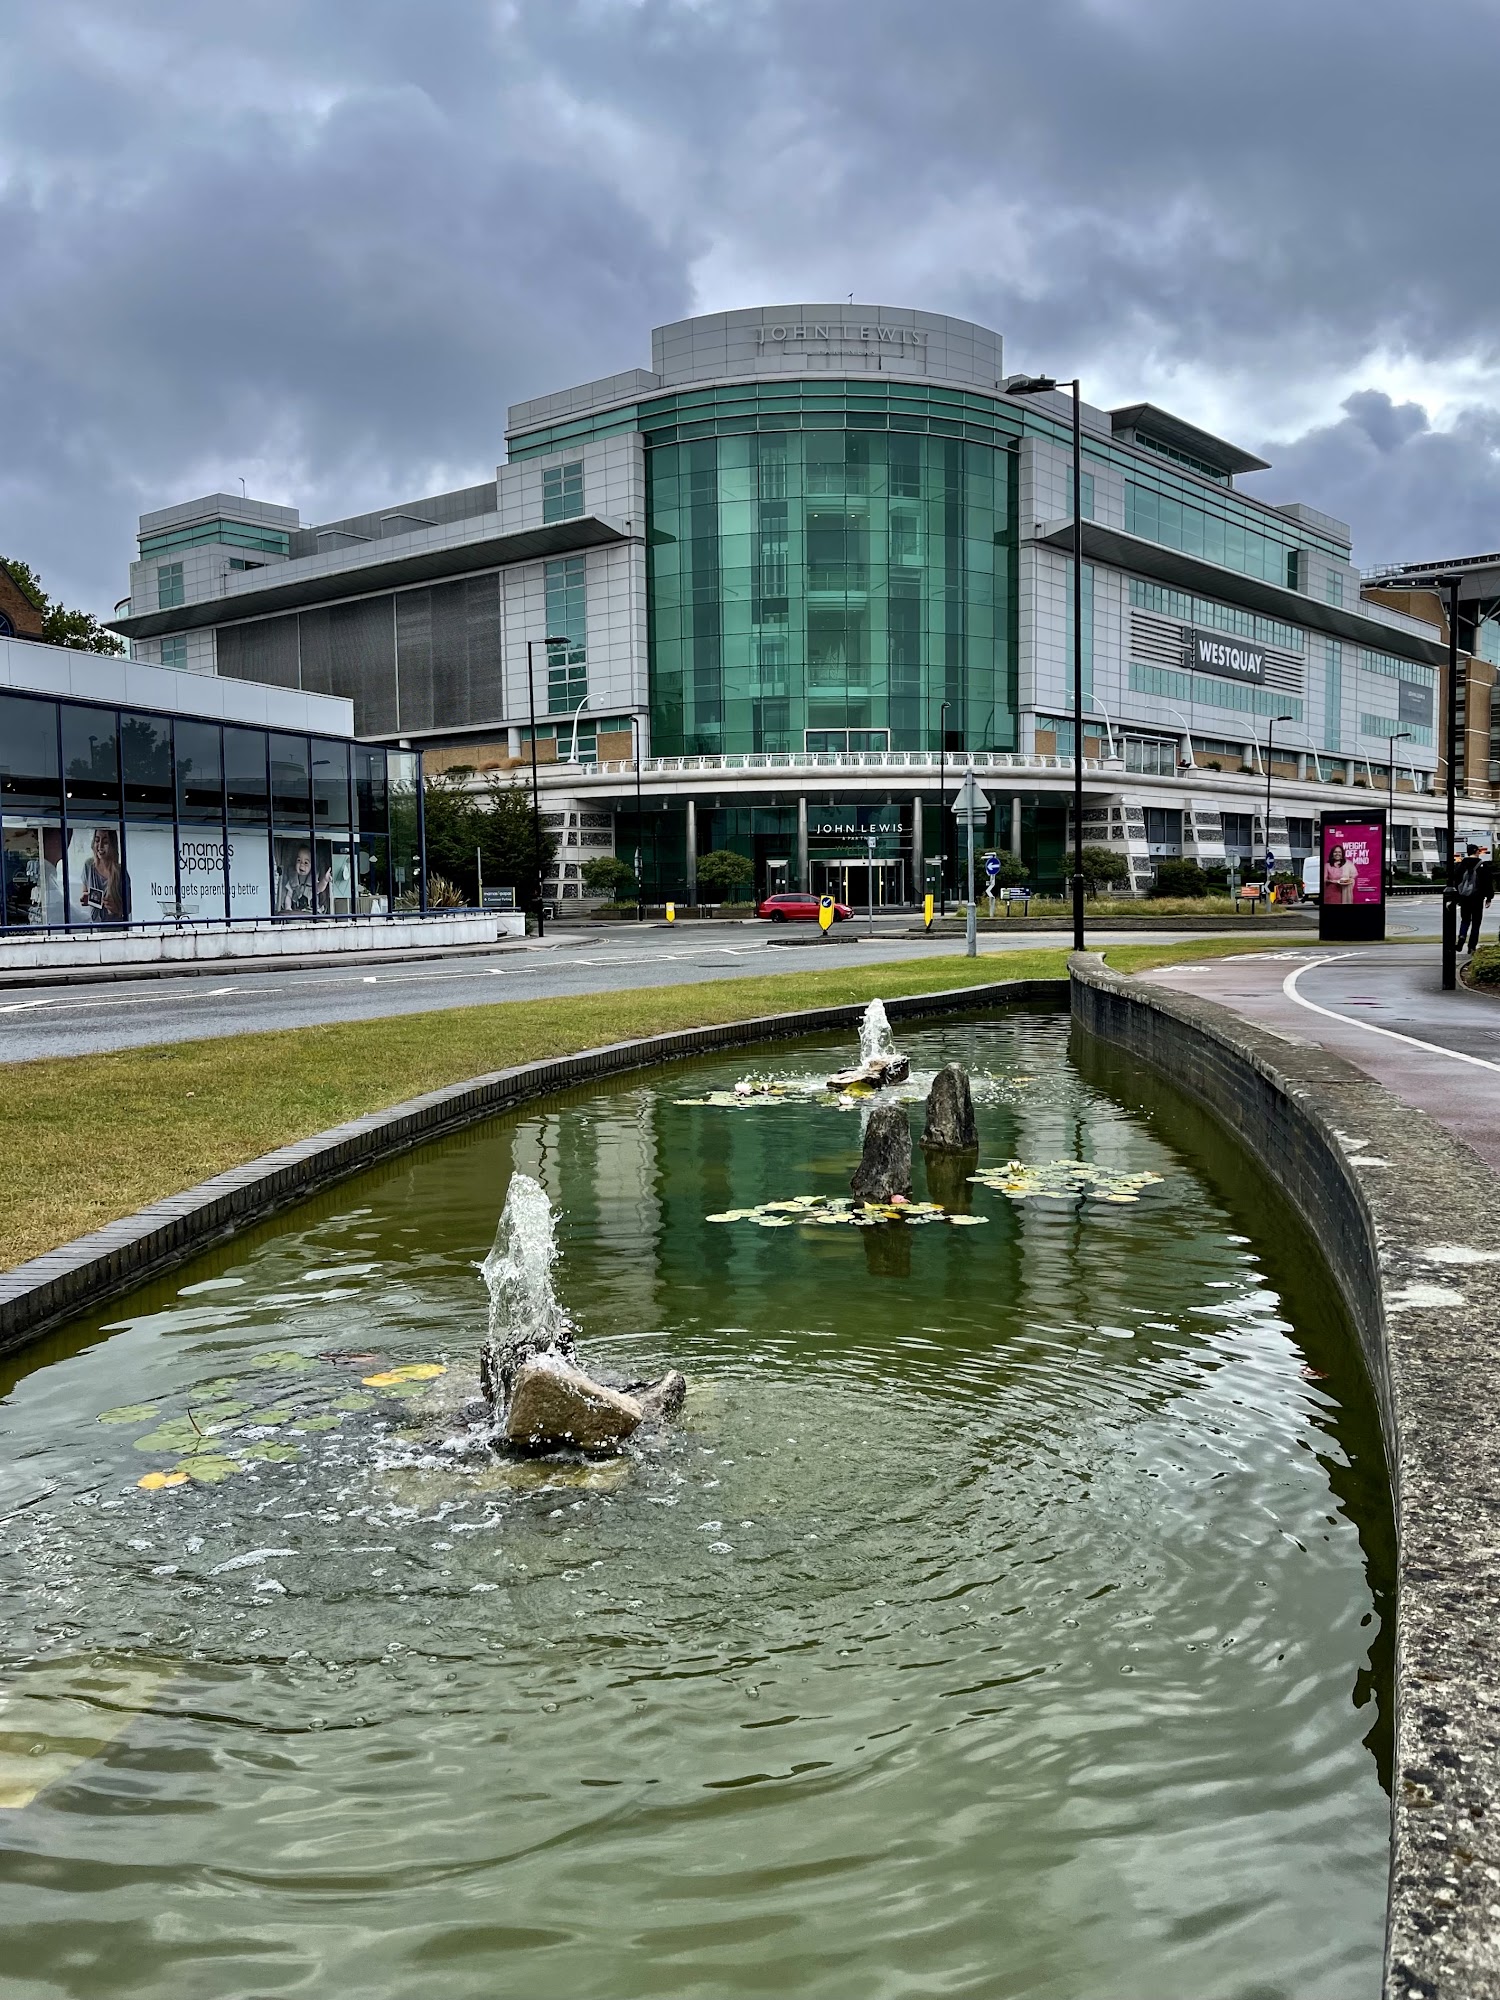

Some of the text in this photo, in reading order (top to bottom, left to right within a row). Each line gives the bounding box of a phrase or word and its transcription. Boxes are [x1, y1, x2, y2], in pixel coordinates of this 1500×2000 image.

[759, 325, 920, 345] JOHN LEWIS
[1199, 639, 1263, 674] WESTQUAY
[816, 823, 903, 834] JOHN LEWIS
[182, 842, 234, 857] mamas
[1342, 841, 1367, 850] WEIGHT
[1345, 849, 1370, 858] OFF MY
[1352, 857, 1370, 865] MIND
[151, 882, 162, 896] No
[164, 885, 178, 896] on
[181, 883, 198, 899] gets
[237, 882, 259, 896] better
